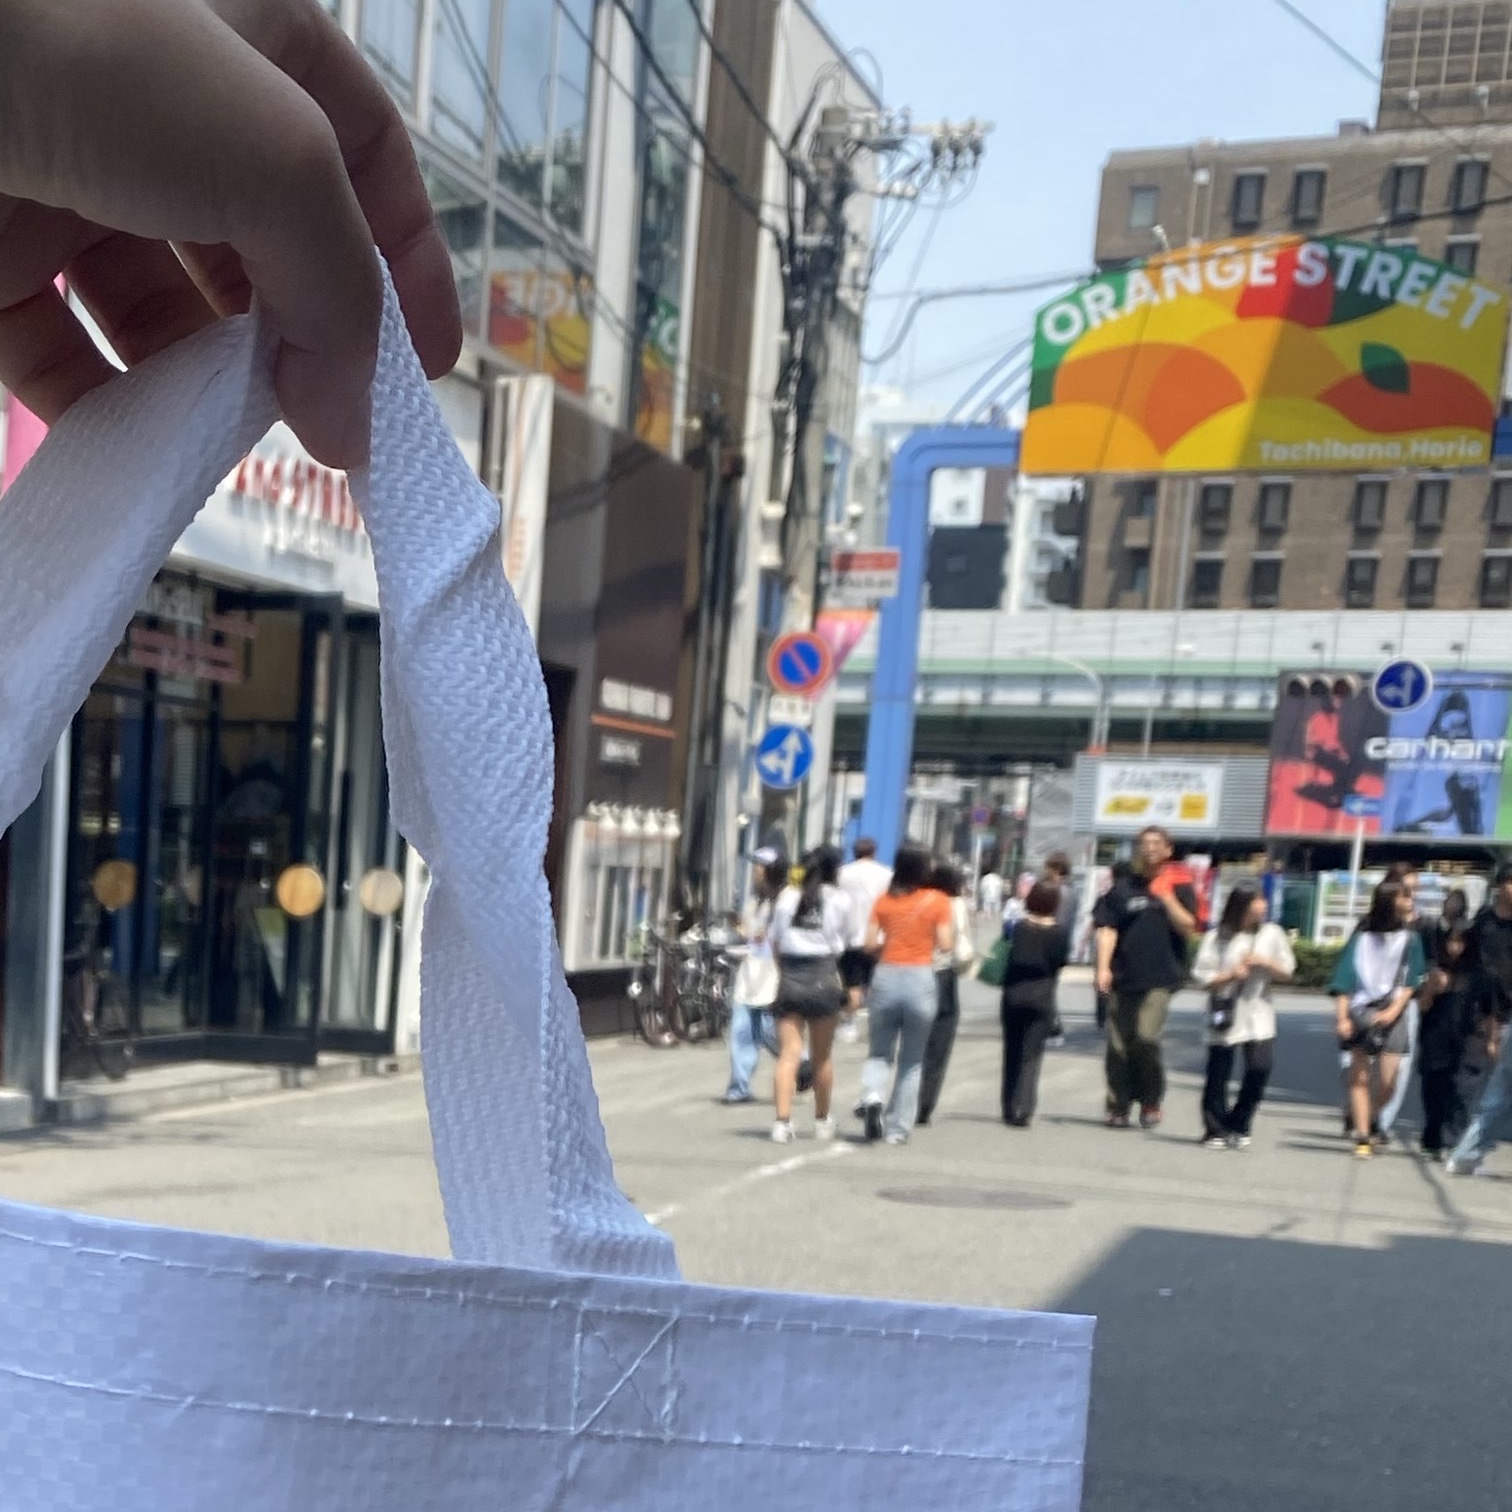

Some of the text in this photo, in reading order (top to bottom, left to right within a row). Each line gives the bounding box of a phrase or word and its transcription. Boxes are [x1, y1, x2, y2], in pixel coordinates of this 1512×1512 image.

[1041, 241, 1501, 345] ORANGE STREET
[1260, 437, 1402, 463] Tachibana
